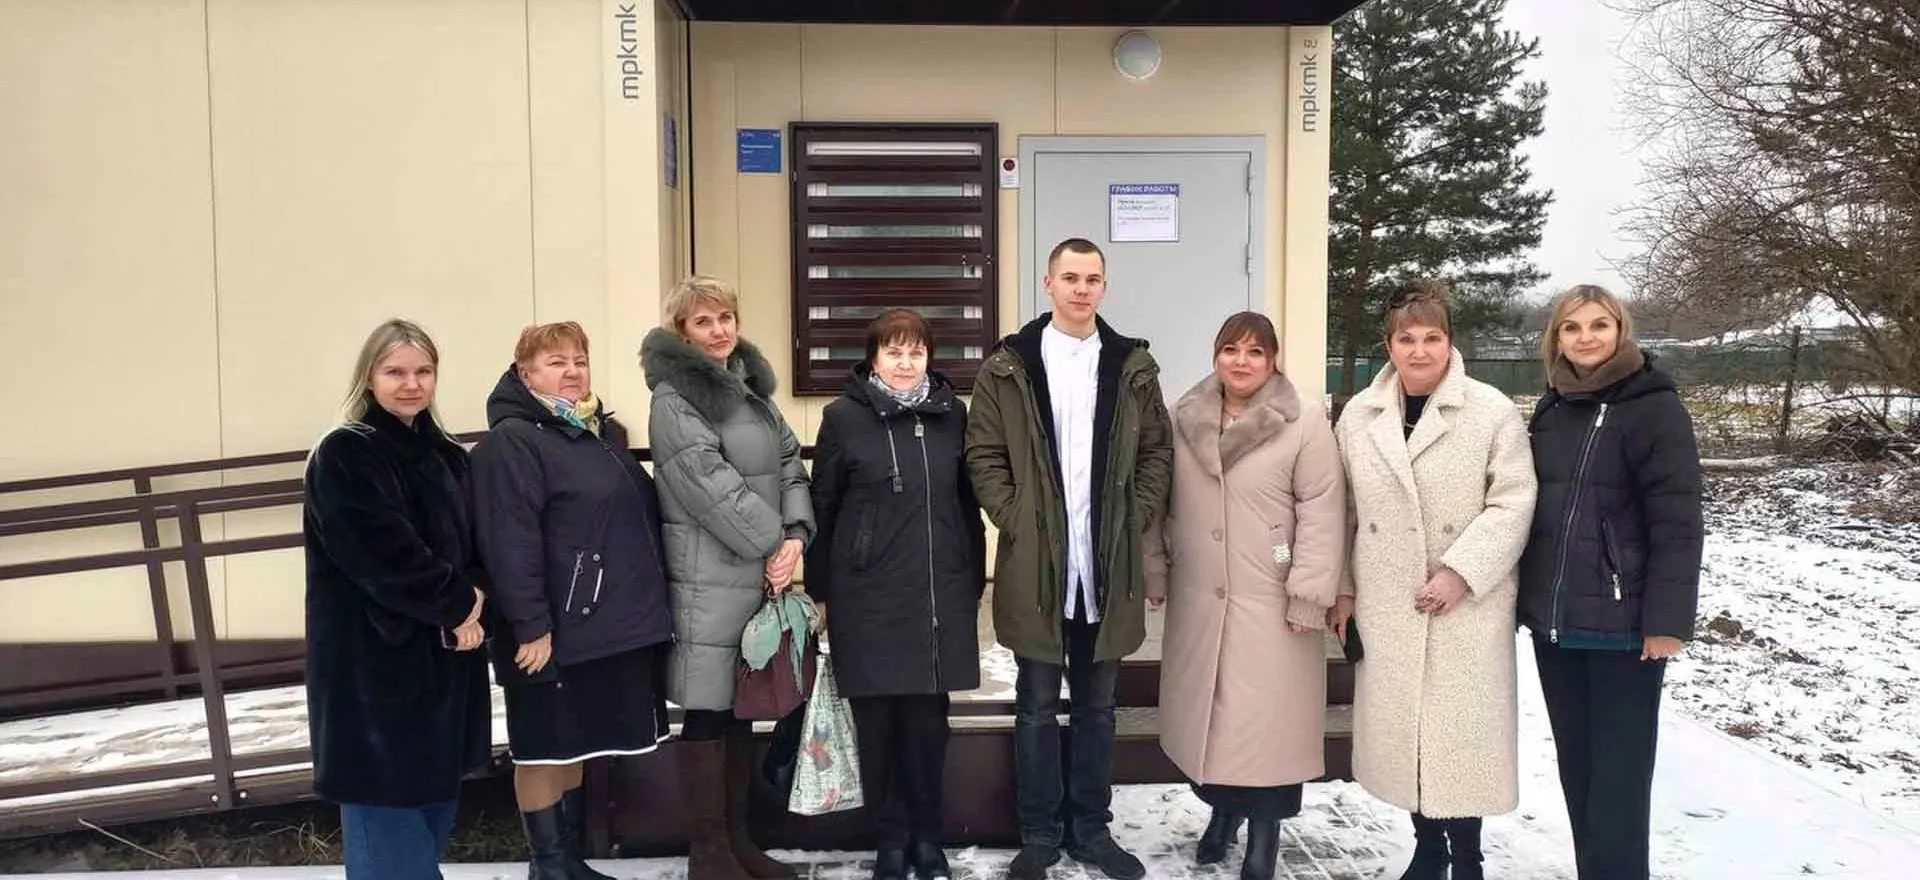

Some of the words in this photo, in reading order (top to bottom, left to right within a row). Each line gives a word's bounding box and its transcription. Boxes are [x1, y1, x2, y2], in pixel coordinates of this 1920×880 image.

[614, 3, 643, 99] mpkmk
[1299, 54, 1320, 132] mpkmk
[1111, 185, 1143, 193] ГРАФИК
[1144, 185, 1177, 193] РАБОТЫ
